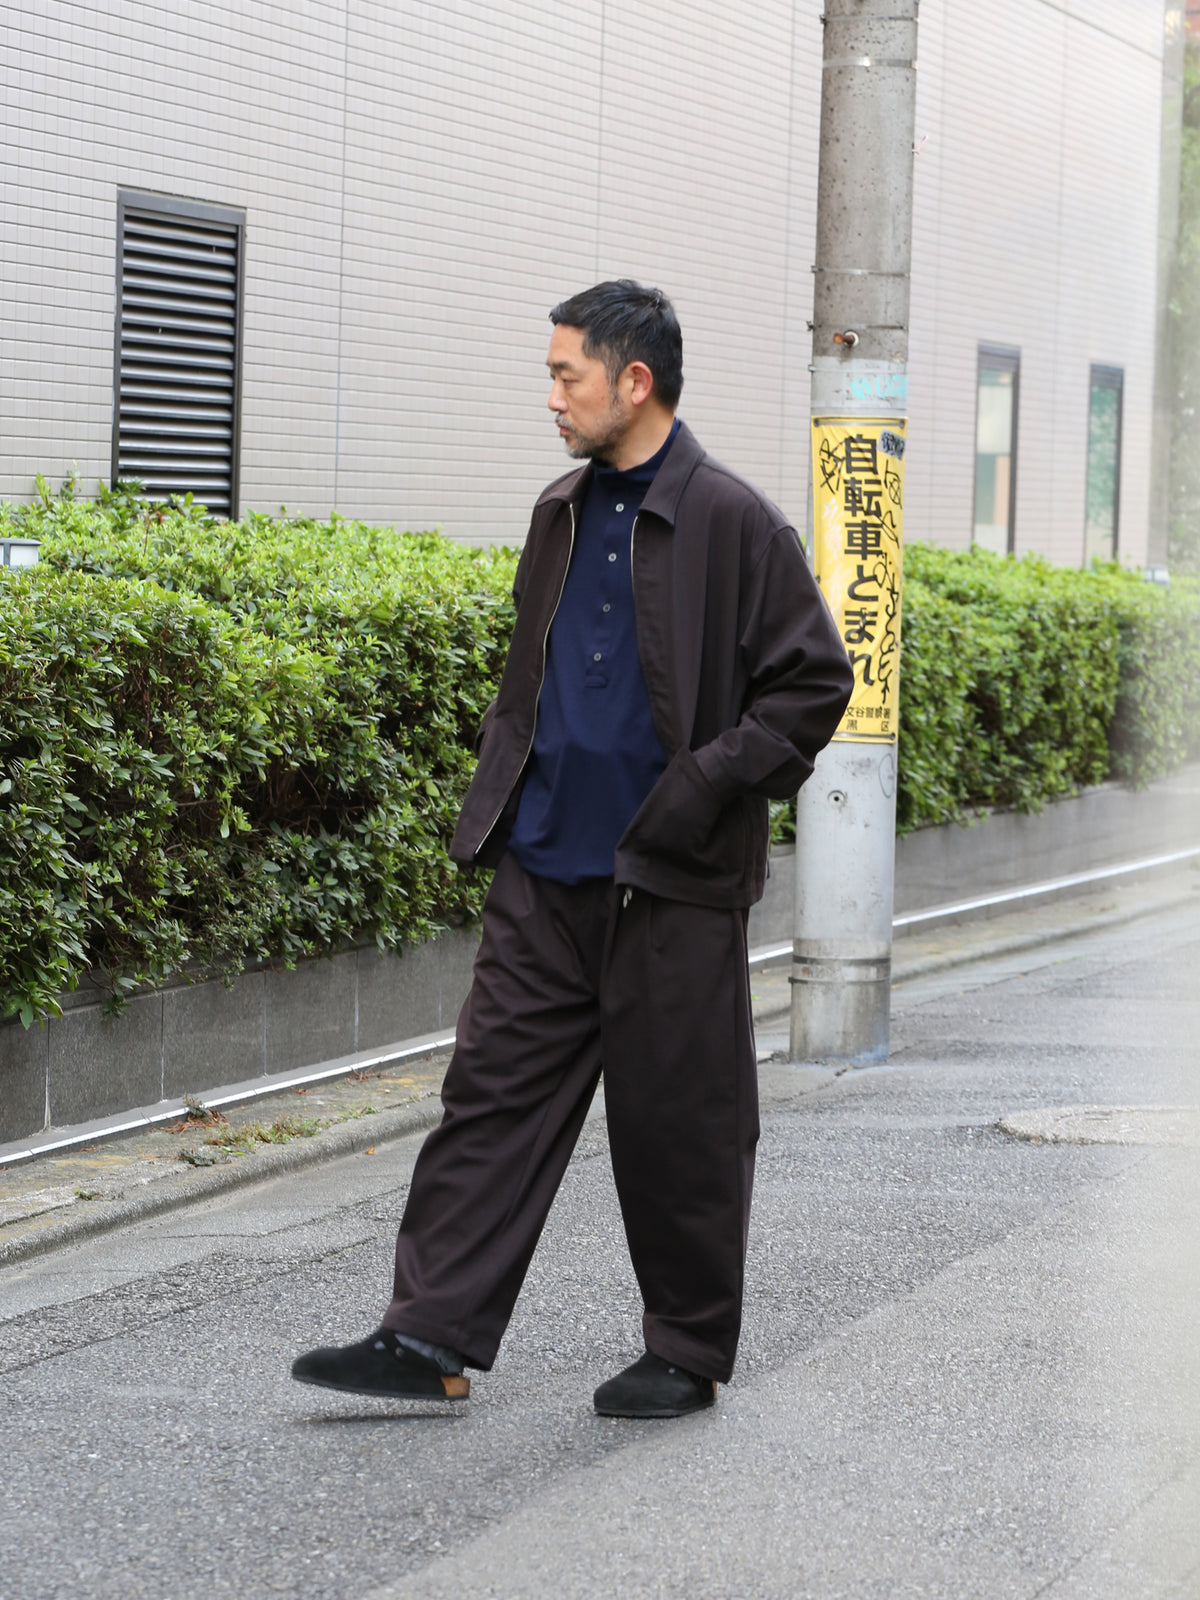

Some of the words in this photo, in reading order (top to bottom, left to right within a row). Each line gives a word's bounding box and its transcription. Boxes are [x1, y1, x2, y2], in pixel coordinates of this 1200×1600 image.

[843, 434, 883, 686] 自転車とまれ
[845, 706, 891, 719] 文谷警察署
